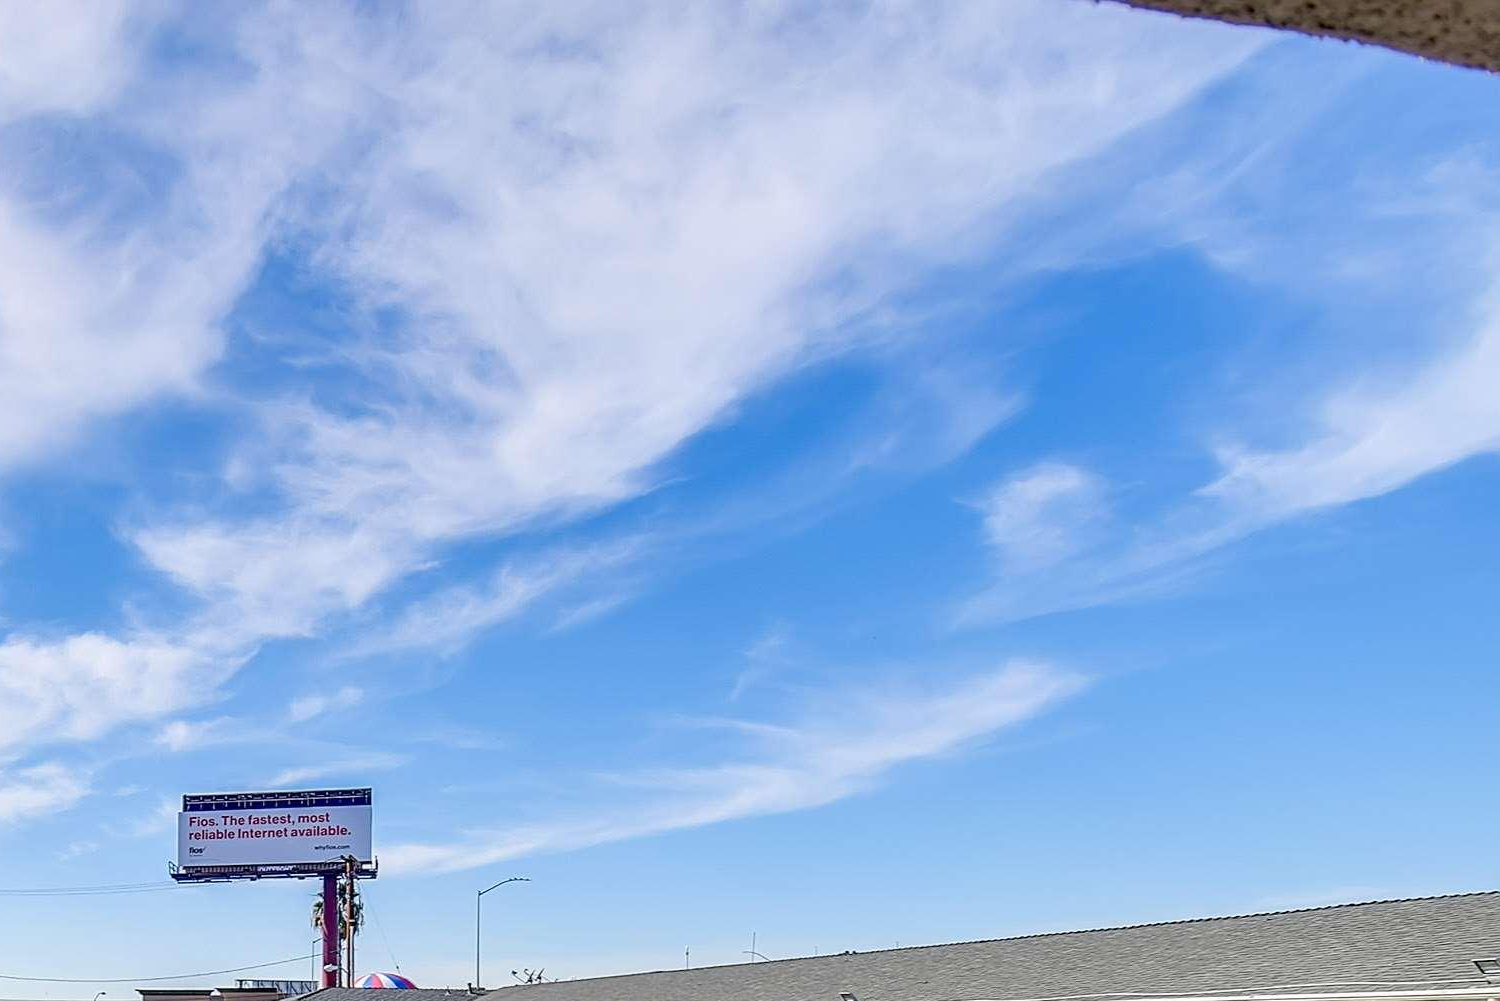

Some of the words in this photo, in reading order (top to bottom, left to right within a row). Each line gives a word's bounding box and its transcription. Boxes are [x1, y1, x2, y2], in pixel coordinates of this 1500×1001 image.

[188, 816, 218, 828] Fios.
[221, 815, 245, 826] The
[248, 813, 296, 826] fastest,
[297, 812, 331, 824] most
[188, 829, 235, 841] reliable
[237, 827, 289, 840] Internet
[290, 825, 352, 838] available.
